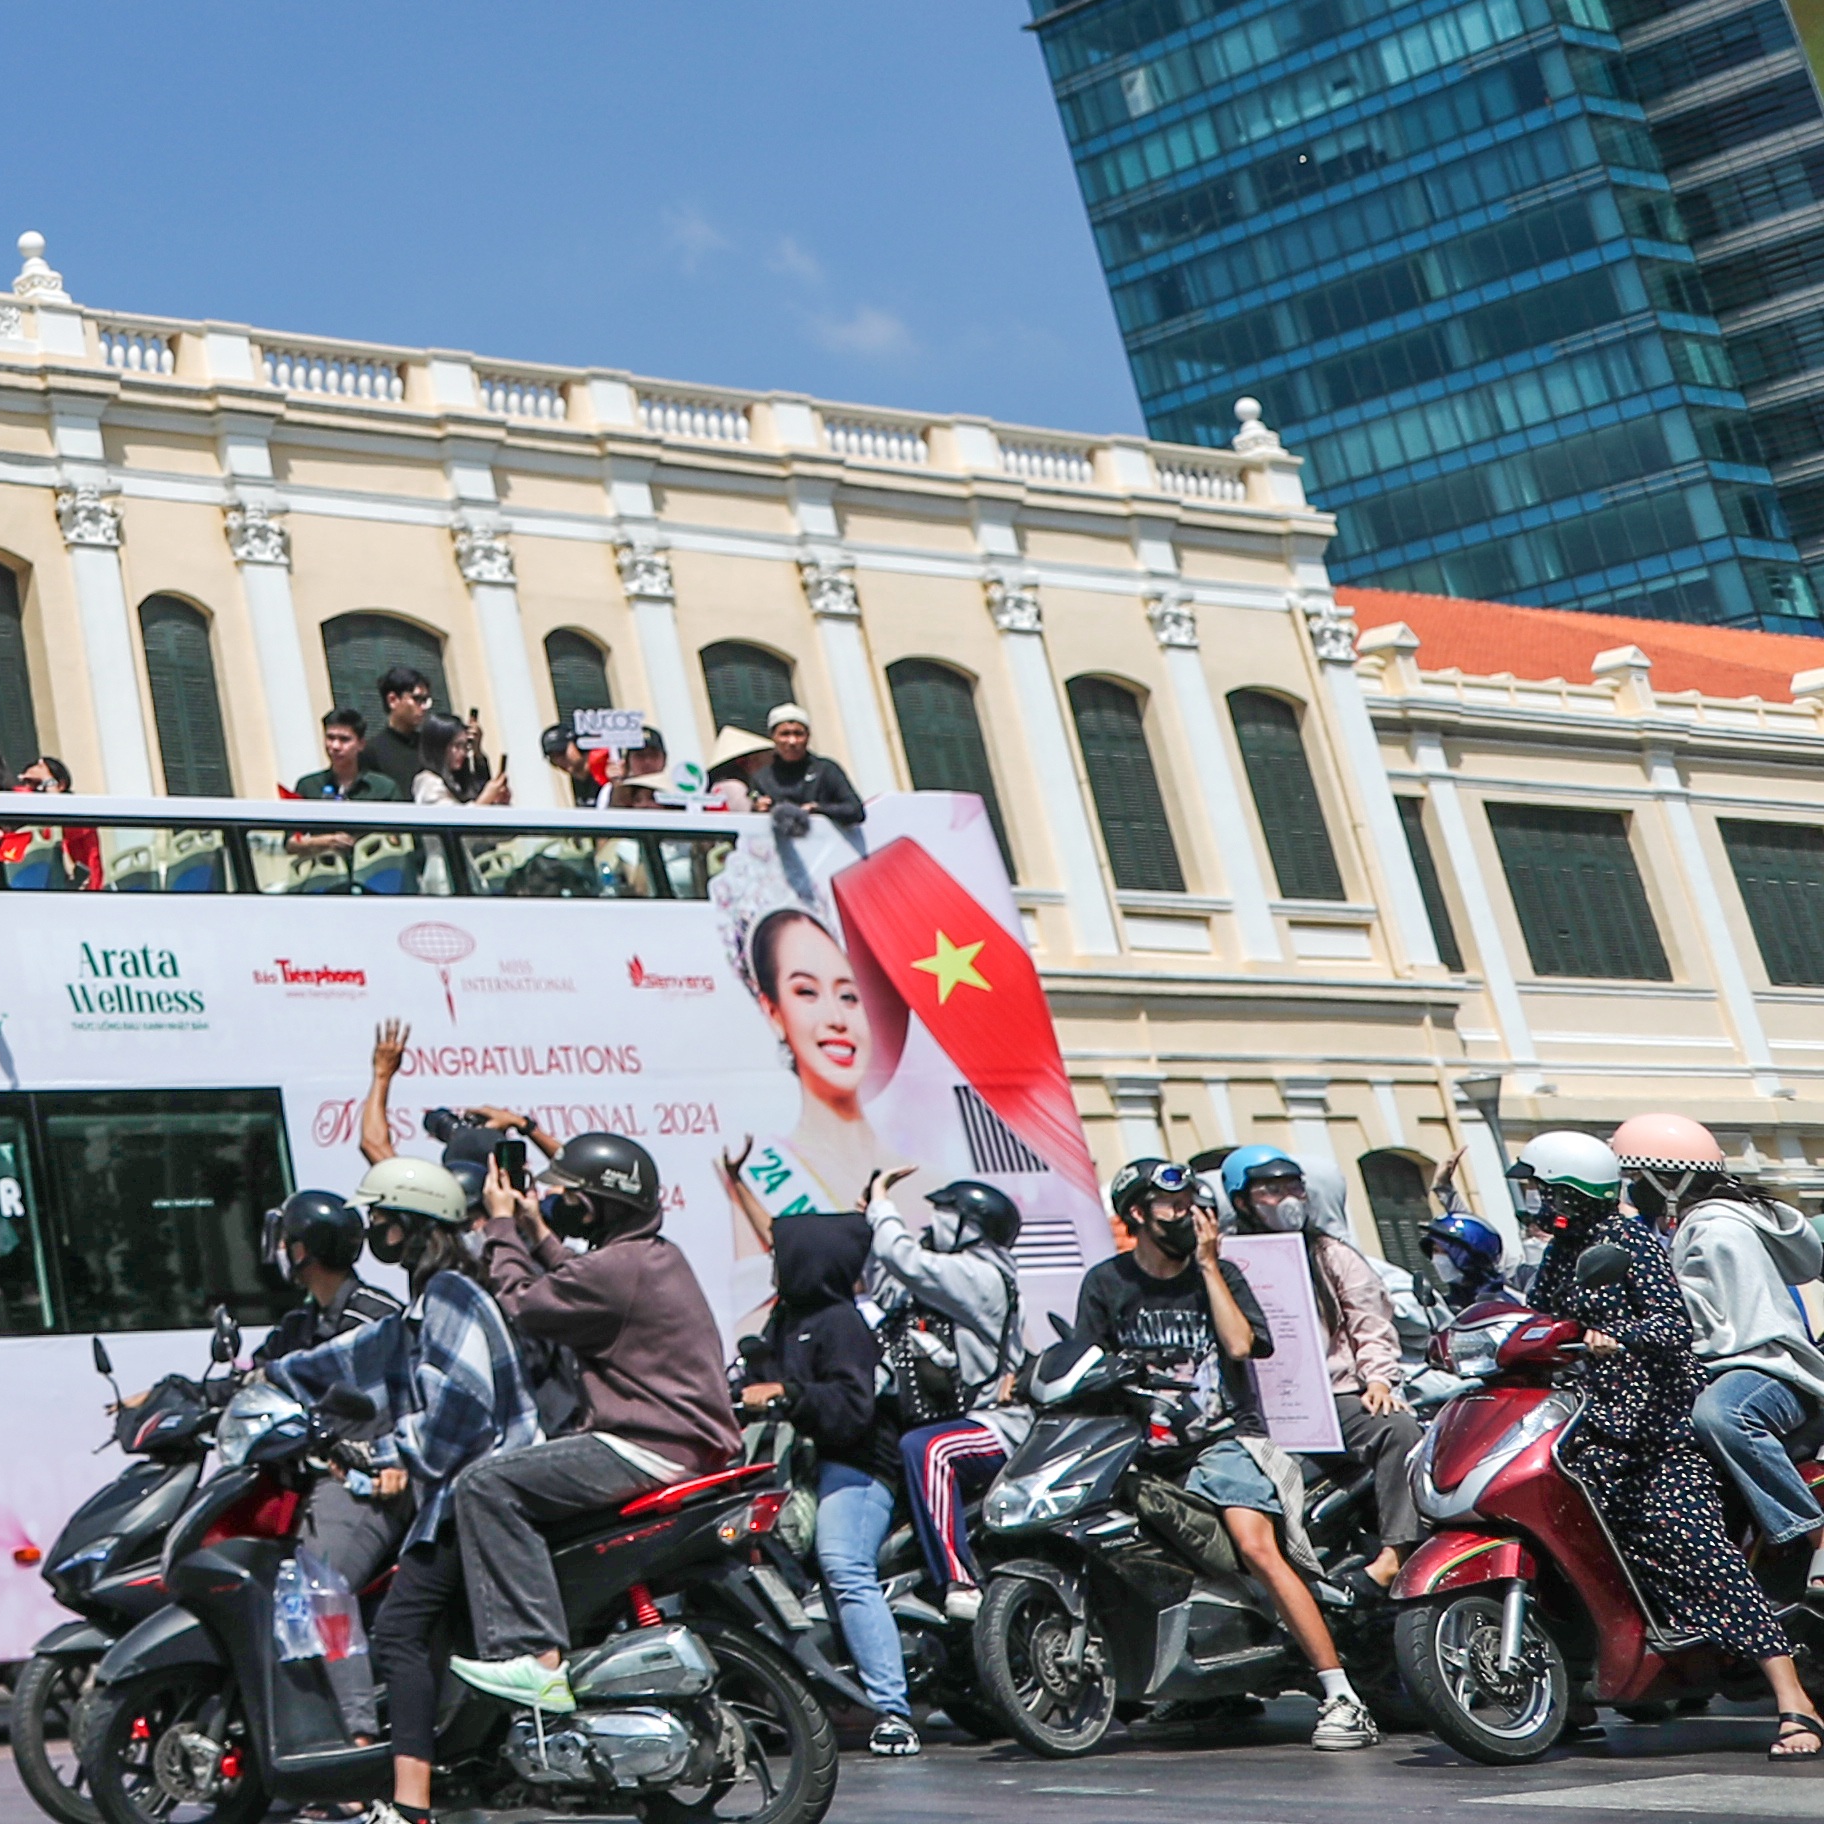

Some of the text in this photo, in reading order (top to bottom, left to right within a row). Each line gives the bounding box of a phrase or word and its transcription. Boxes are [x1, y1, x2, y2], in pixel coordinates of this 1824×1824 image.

[78, 941, 180, 979] Arata
[66, 982, 205, 1014] Wellness
[399, 1043, 643, 1078] ONGRATULATIONS
[654, 1102, 720, 1136] 2024
